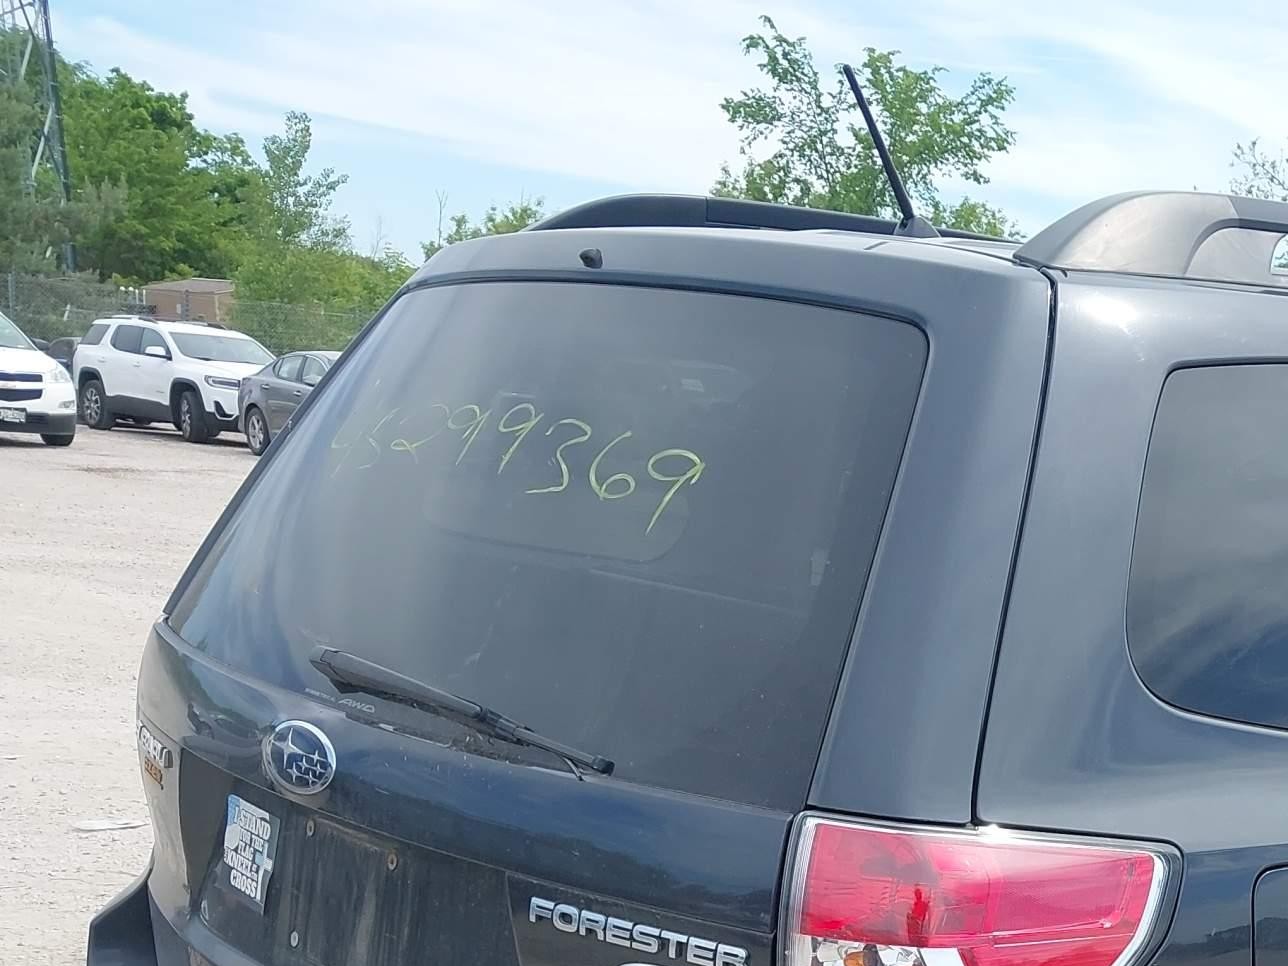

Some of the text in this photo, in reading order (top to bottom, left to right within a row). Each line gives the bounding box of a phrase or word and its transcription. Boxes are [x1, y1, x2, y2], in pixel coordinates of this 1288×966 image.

[330, 401, 706, 536] 45299369
[338, 698, 376, 713] AWD
[239, 808, 271, 841] STAND
[237, 841, 254, 861] FLAG
[251, 834, 264, 852] THE
[227, 849, 252, 876] KNEEL
[230, 868, 257, 898] CROSS
